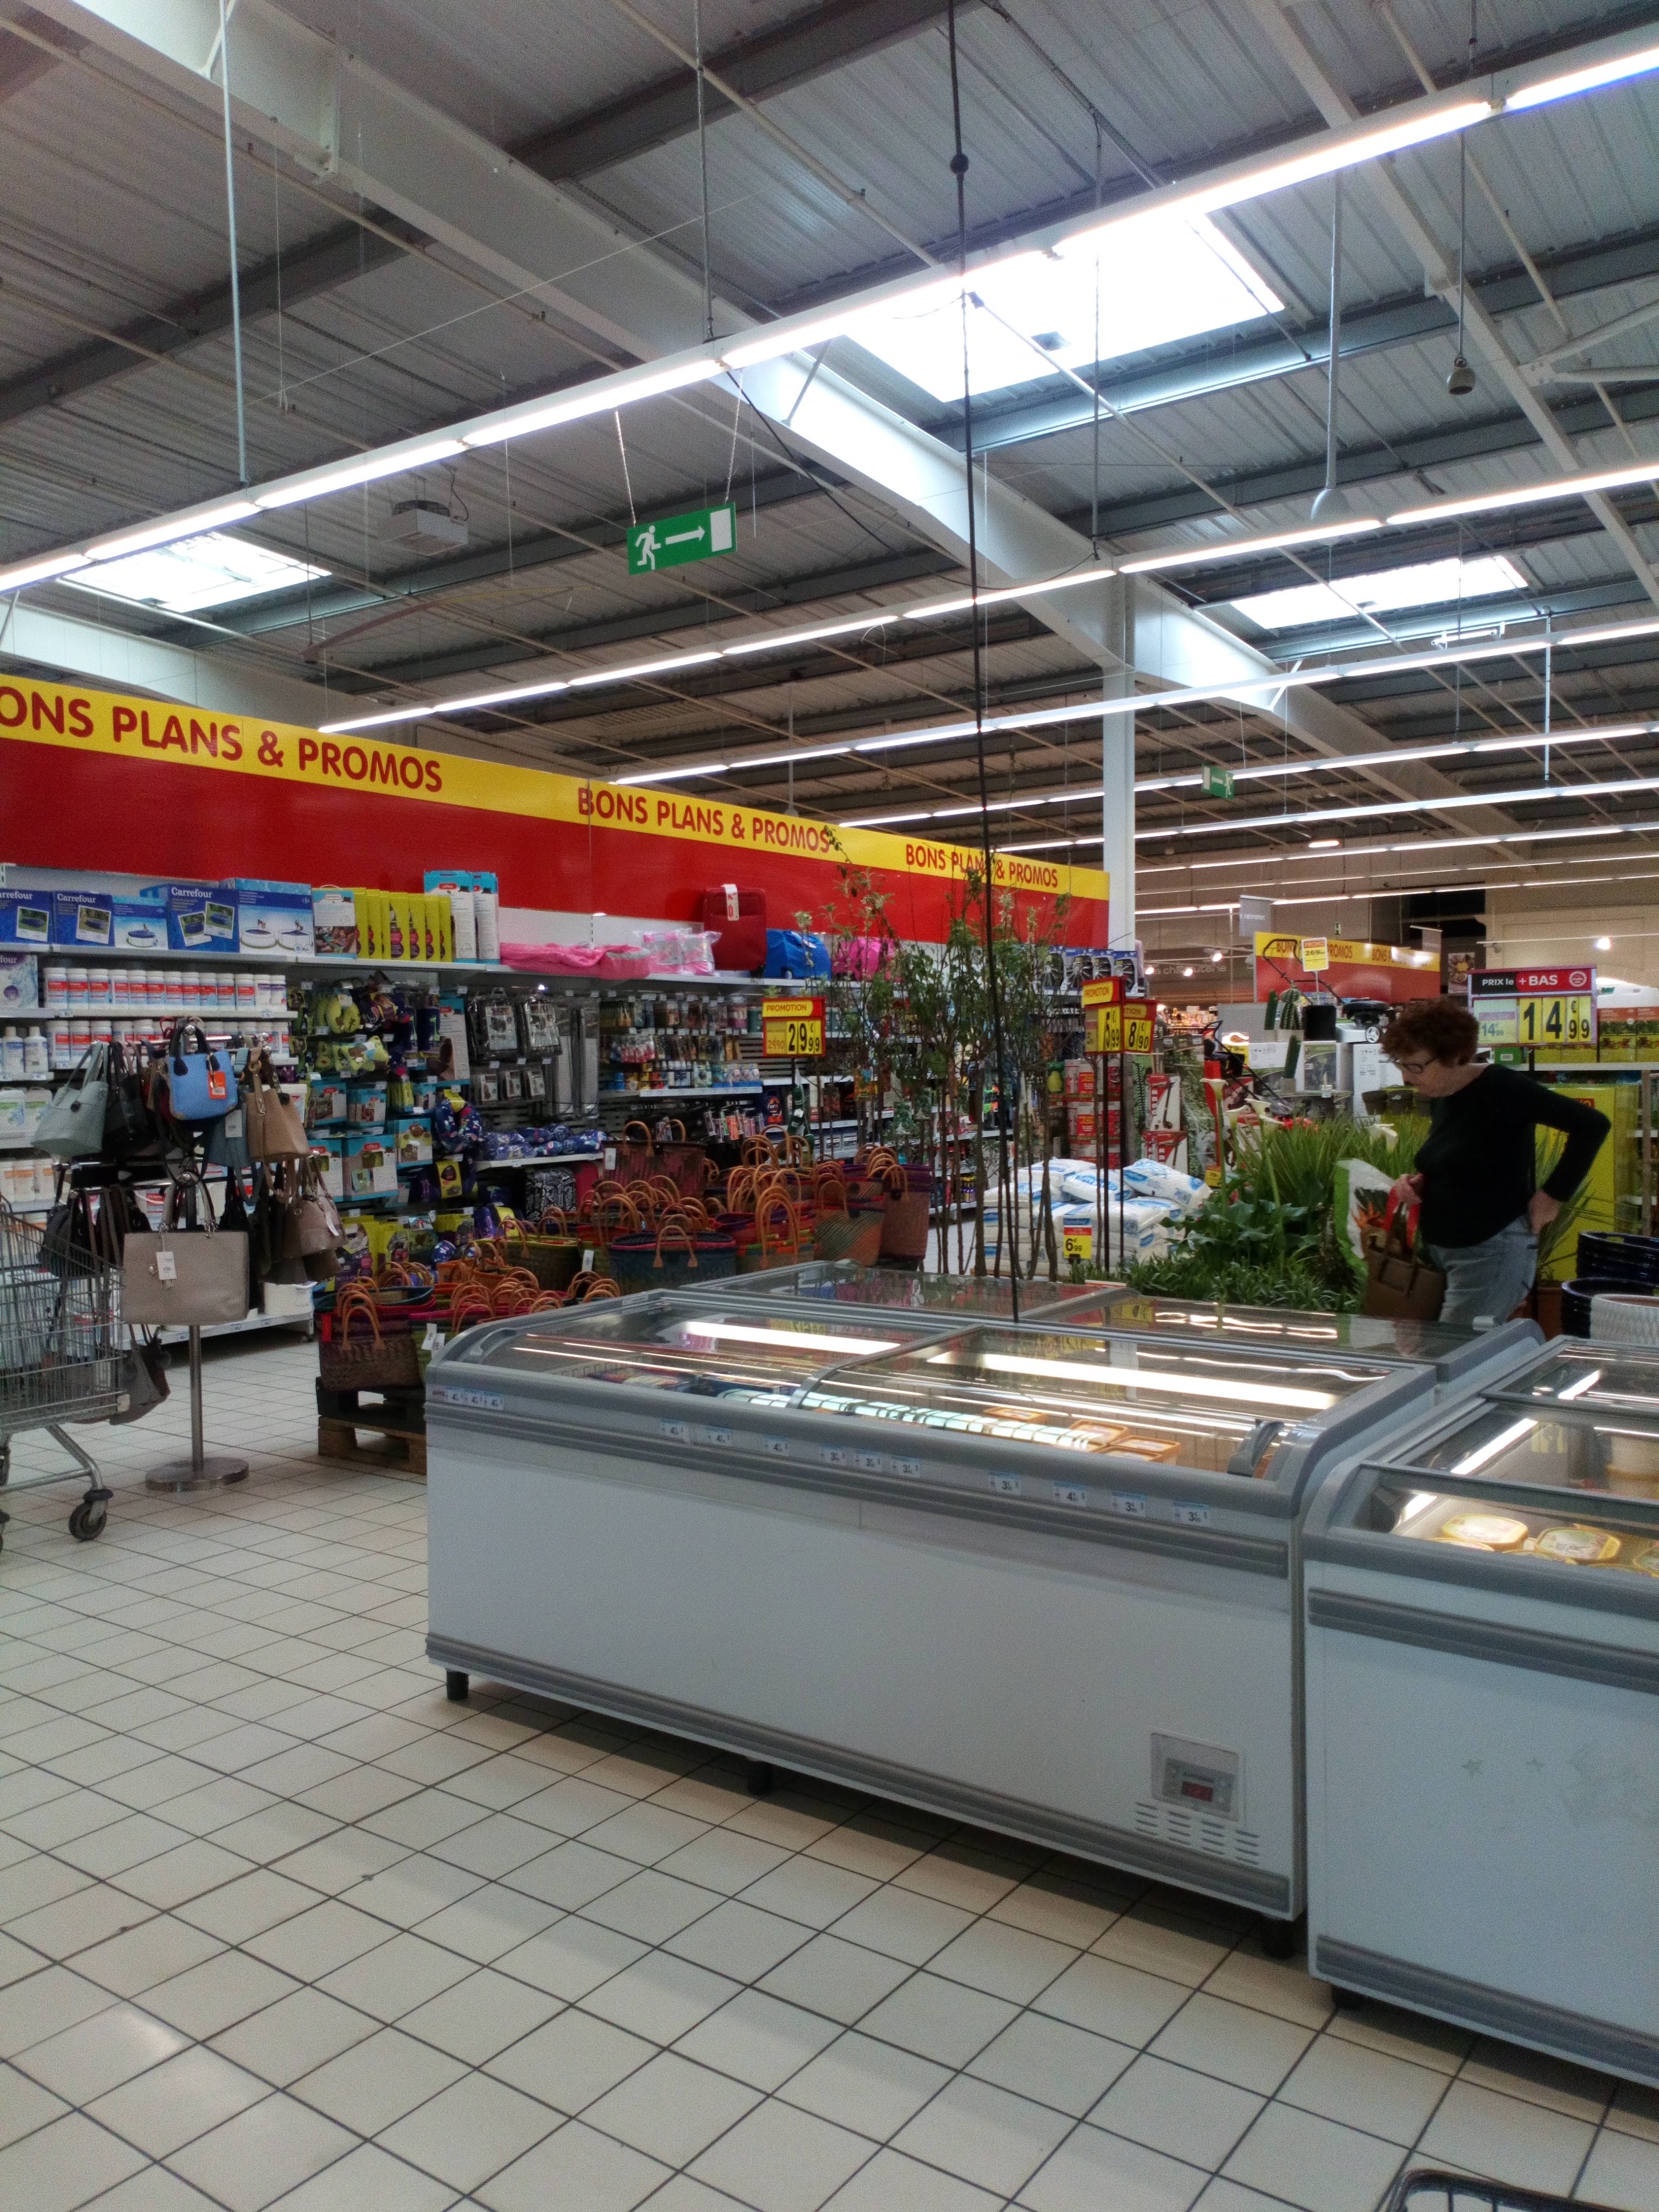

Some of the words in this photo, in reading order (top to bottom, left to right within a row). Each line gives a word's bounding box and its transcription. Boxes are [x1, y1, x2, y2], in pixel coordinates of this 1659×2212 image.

[0, 687, 93, 737] ONS
[113, 706, 242, 760] PLANS
[258, 731, 284, 766] &
[299, 738, 442, 792] PROMOS
[578, 787, 648, 824] BONS
[658, 801, 724, 835] PLANS
[731, 813, 744, 839] &
[753, 818, 830, 853] PROMOS
[906, 844, 946, 870] BONS
[952, 852, 992, 875] PLAN
[997, 860, 1004, 879] &
[1009, 863, 1058, 887] PROMOS
[0, 891, 32, 900] arrefour
[57, 893, 96, 903] Carrefour
[172, 887, 212, 898] Carrefour
[1528, 975, 1557, 986] BAS
[788, 1023, 807, 1051] 29
